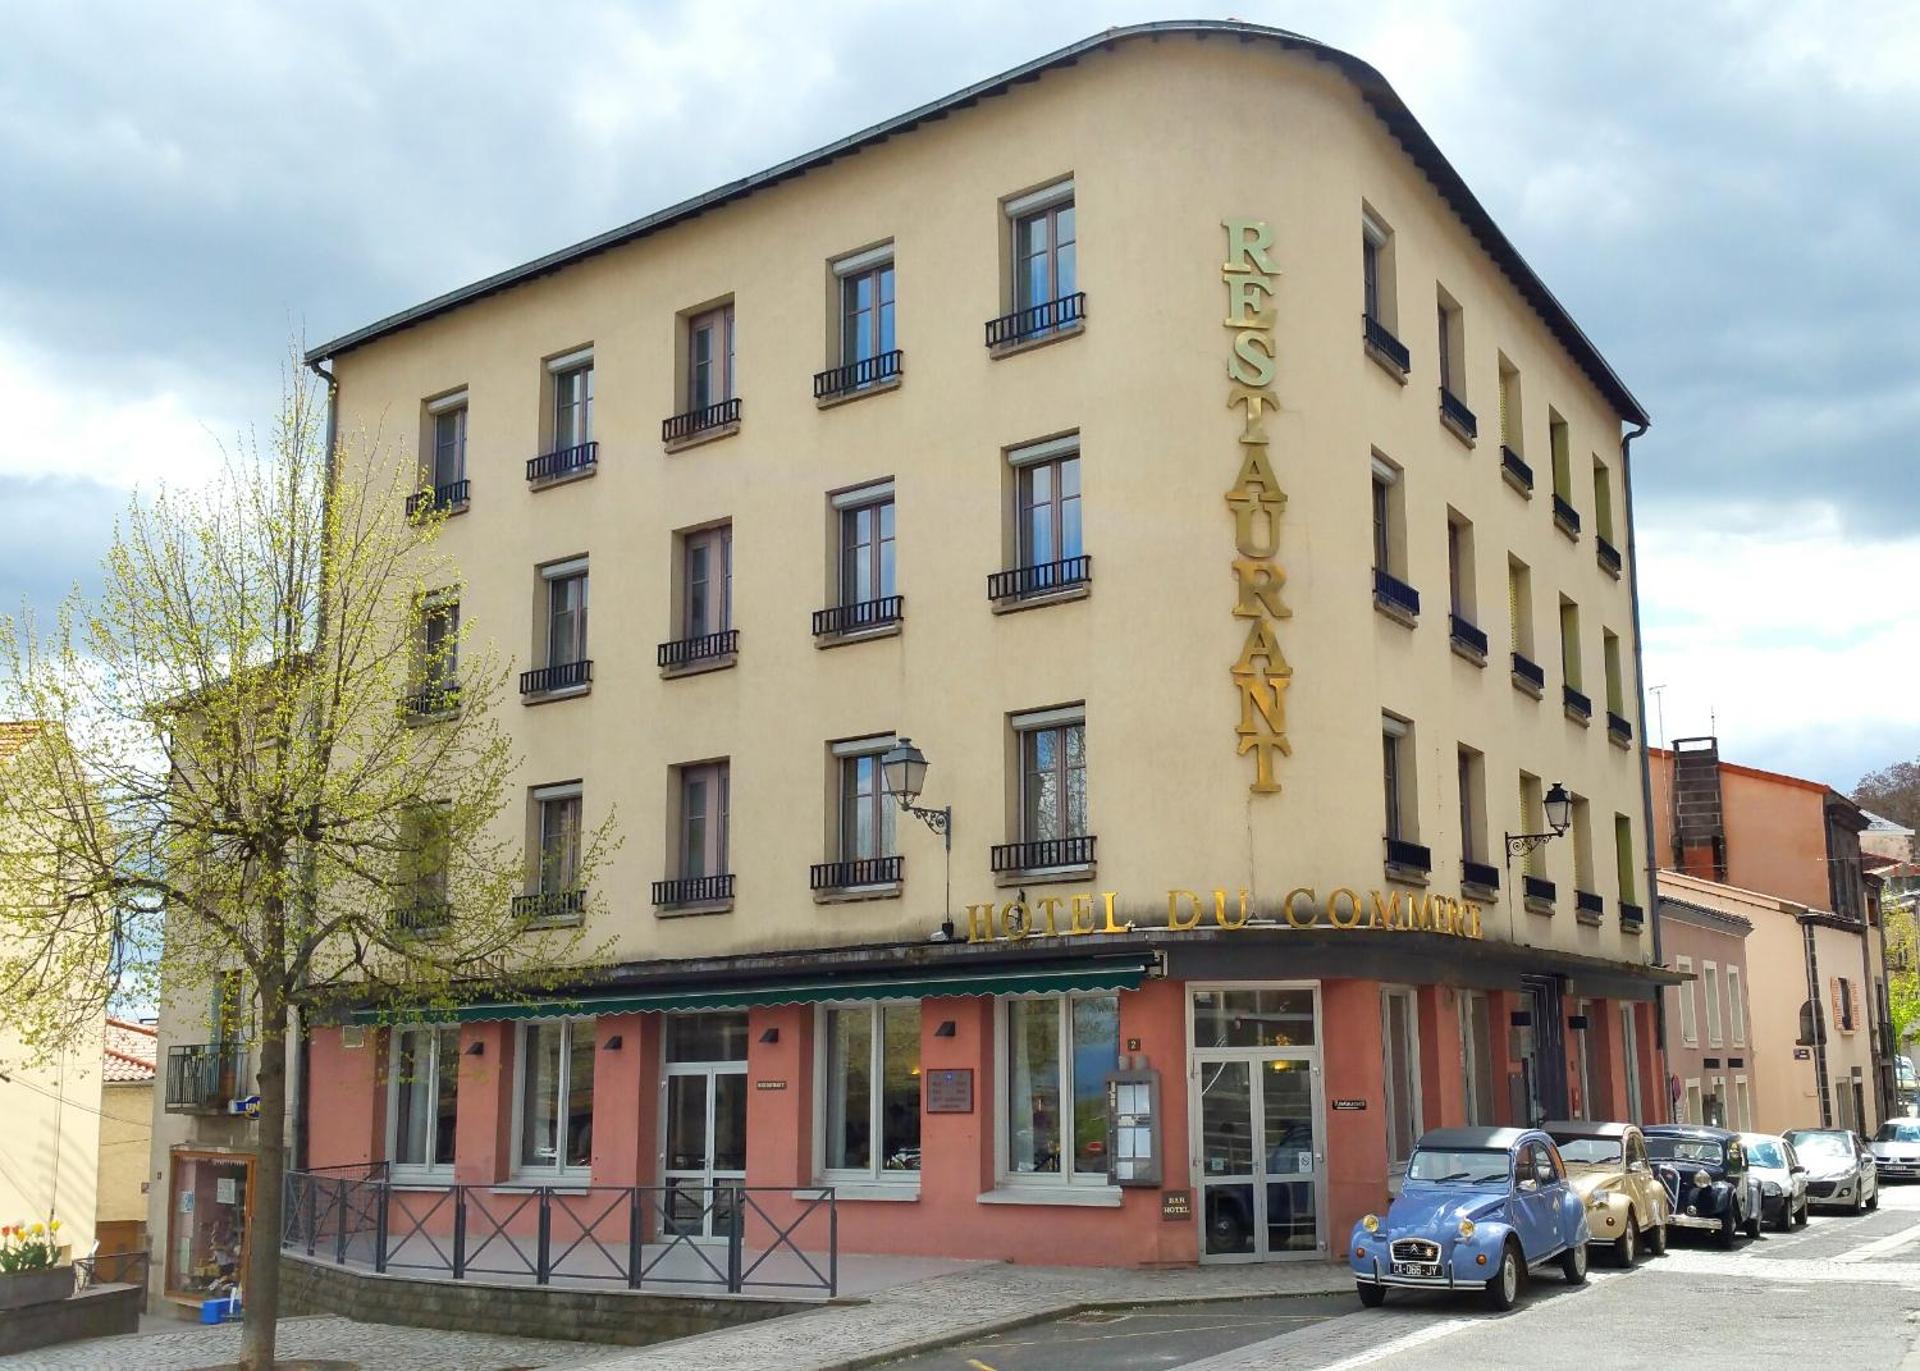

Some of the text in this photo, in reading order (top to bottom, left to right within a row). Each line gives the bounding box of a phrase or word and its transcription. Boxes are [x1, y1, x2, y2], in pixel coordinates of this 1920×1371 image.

[1221, 218, 1293, 792] RESTAURANT
[965, 886, 1483, 944] HOTEL DU COMMERCE
